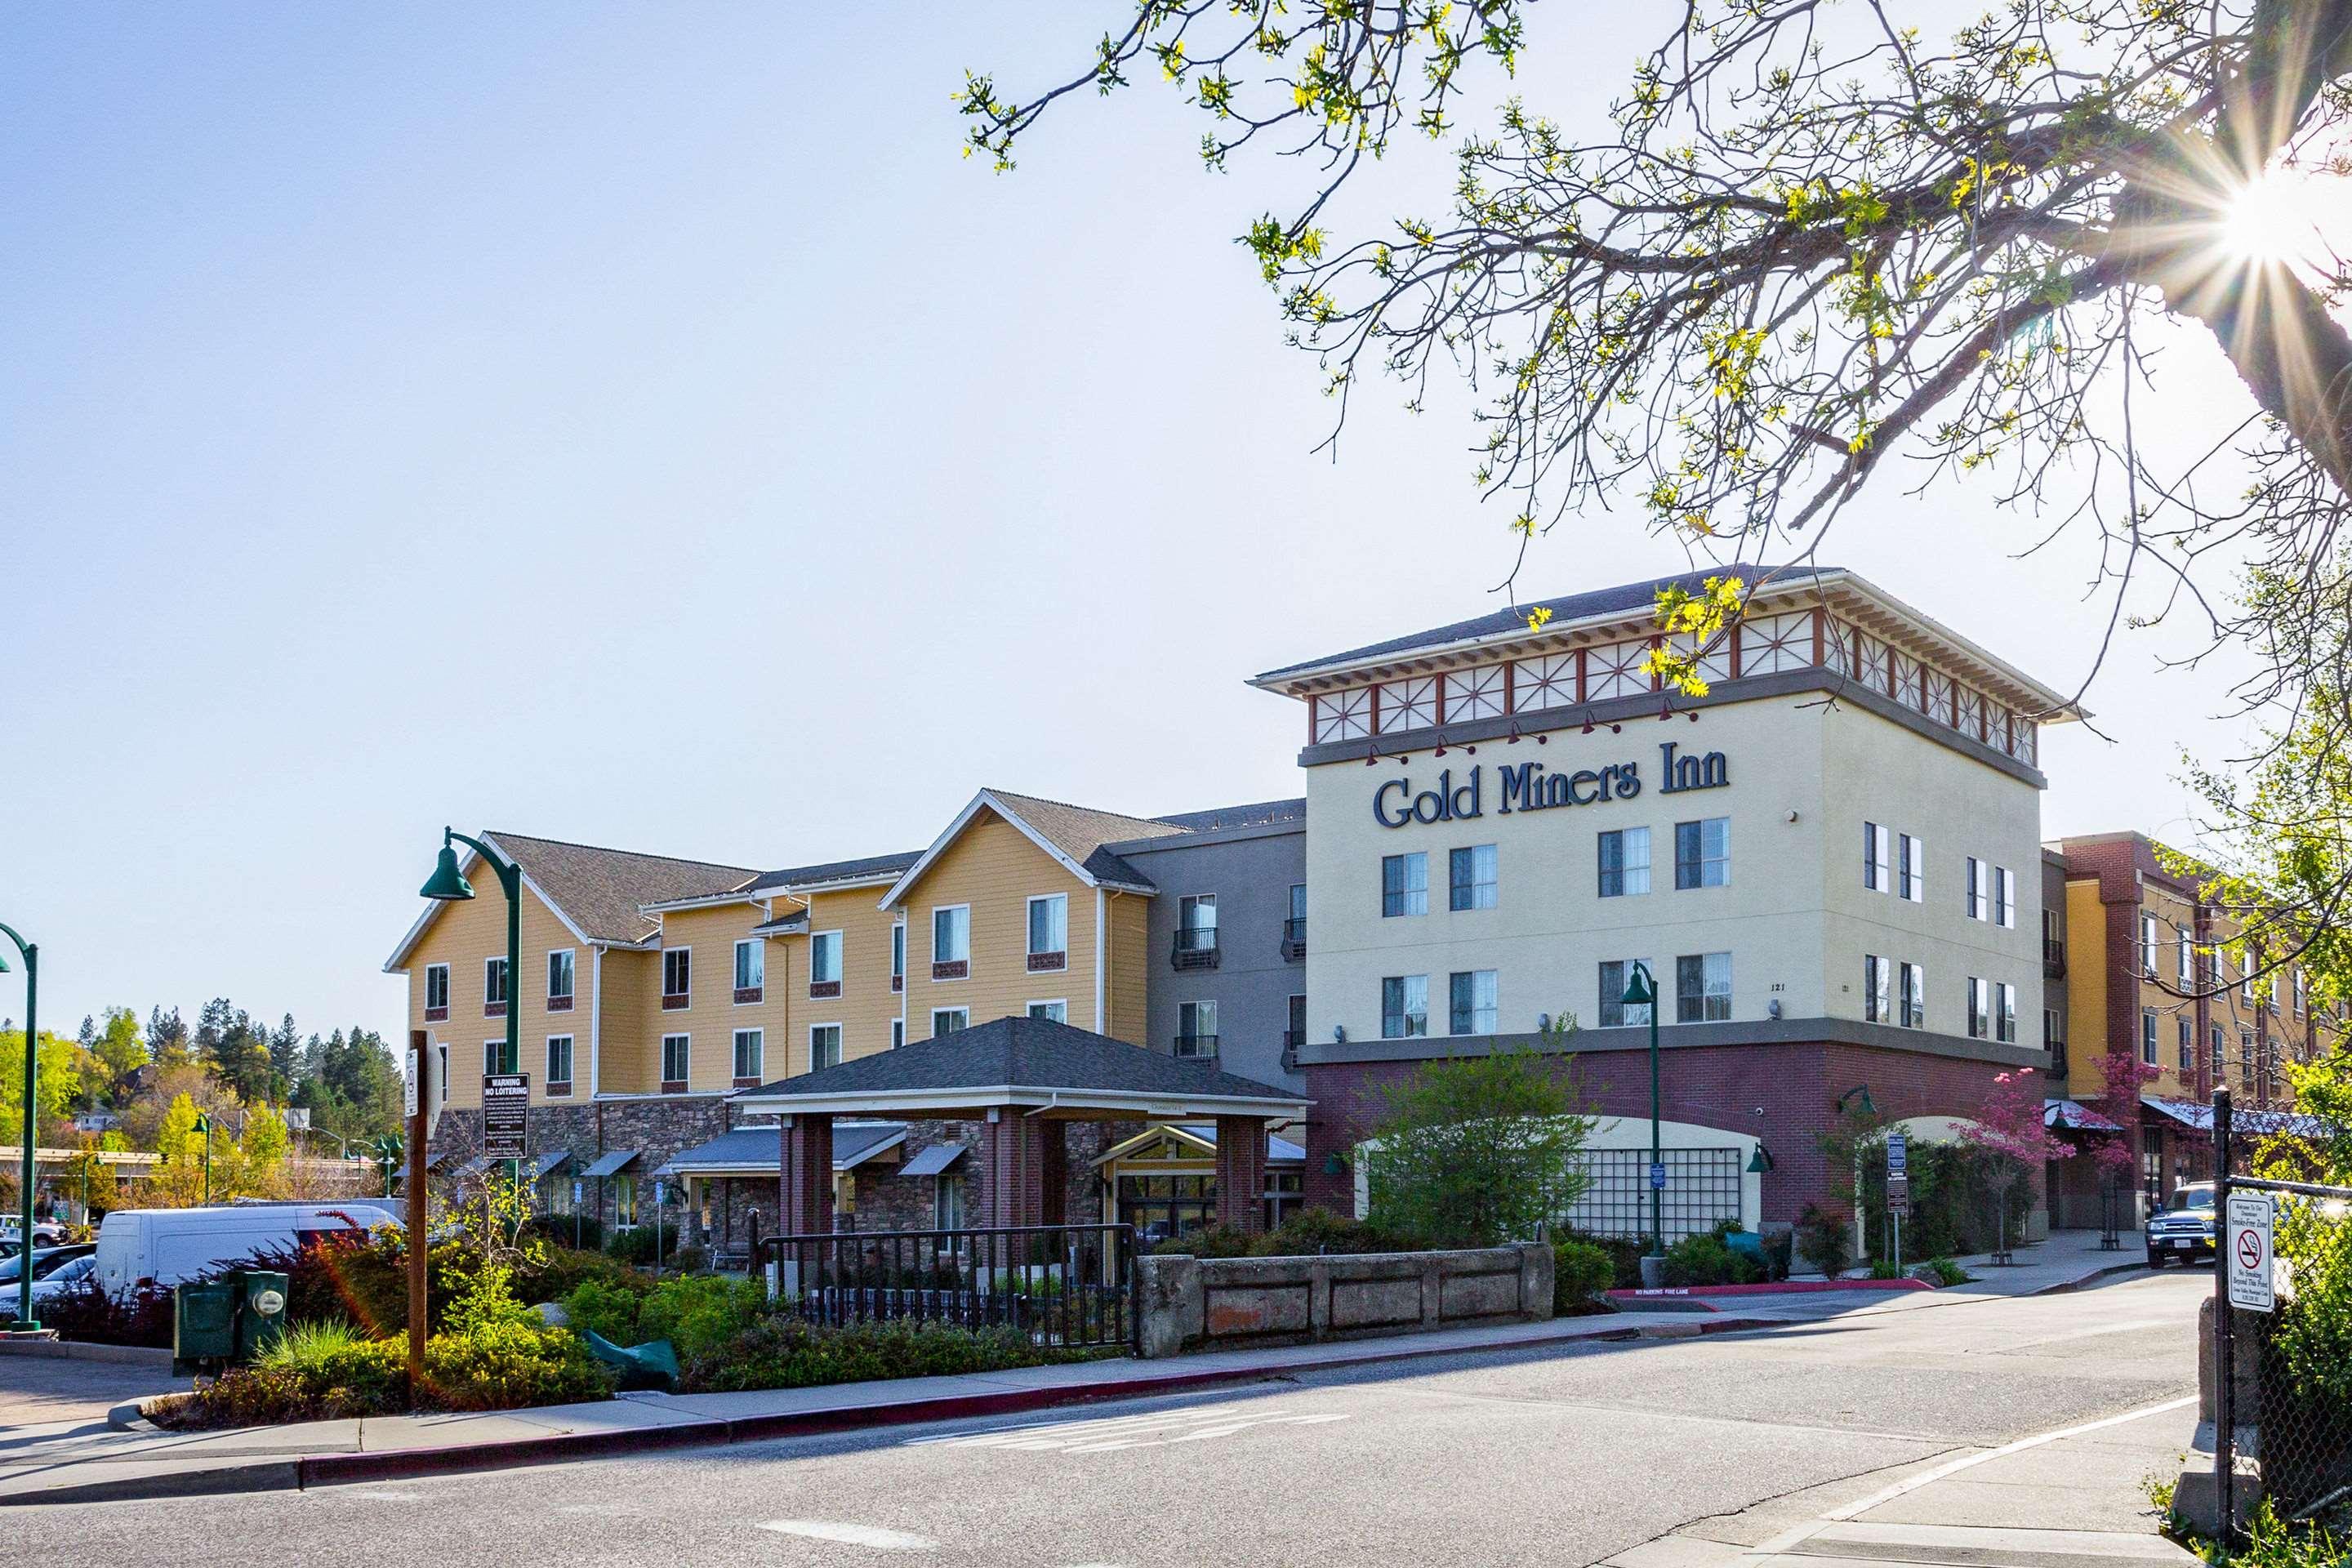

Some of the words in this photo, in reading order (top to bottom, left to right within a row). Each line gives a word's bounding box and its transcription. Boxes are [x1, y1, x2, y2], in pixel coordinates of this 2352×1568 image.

[1373, 764, 1483, 829] Gold
[1497, 760, 1642, 814] Miners
[1658, 741, 1731, 795] Inn
[1771, 983, 1784, 991] 121
[492, 1078, 520, 1086] WARNING
[495, 1087, 527, 1095] LOITERING
[2231, 1217, 2256, 1227] Smoke-Free
[2256, 1218, 2267, 1228] Zone
[2245, 1269, 2262, 1280] Smoking
[2233, 1276, 2247, 1285] Beyond
[2248, 1278, 2256, 1287] This
[2257, 1279, 2268, 1288] Point
